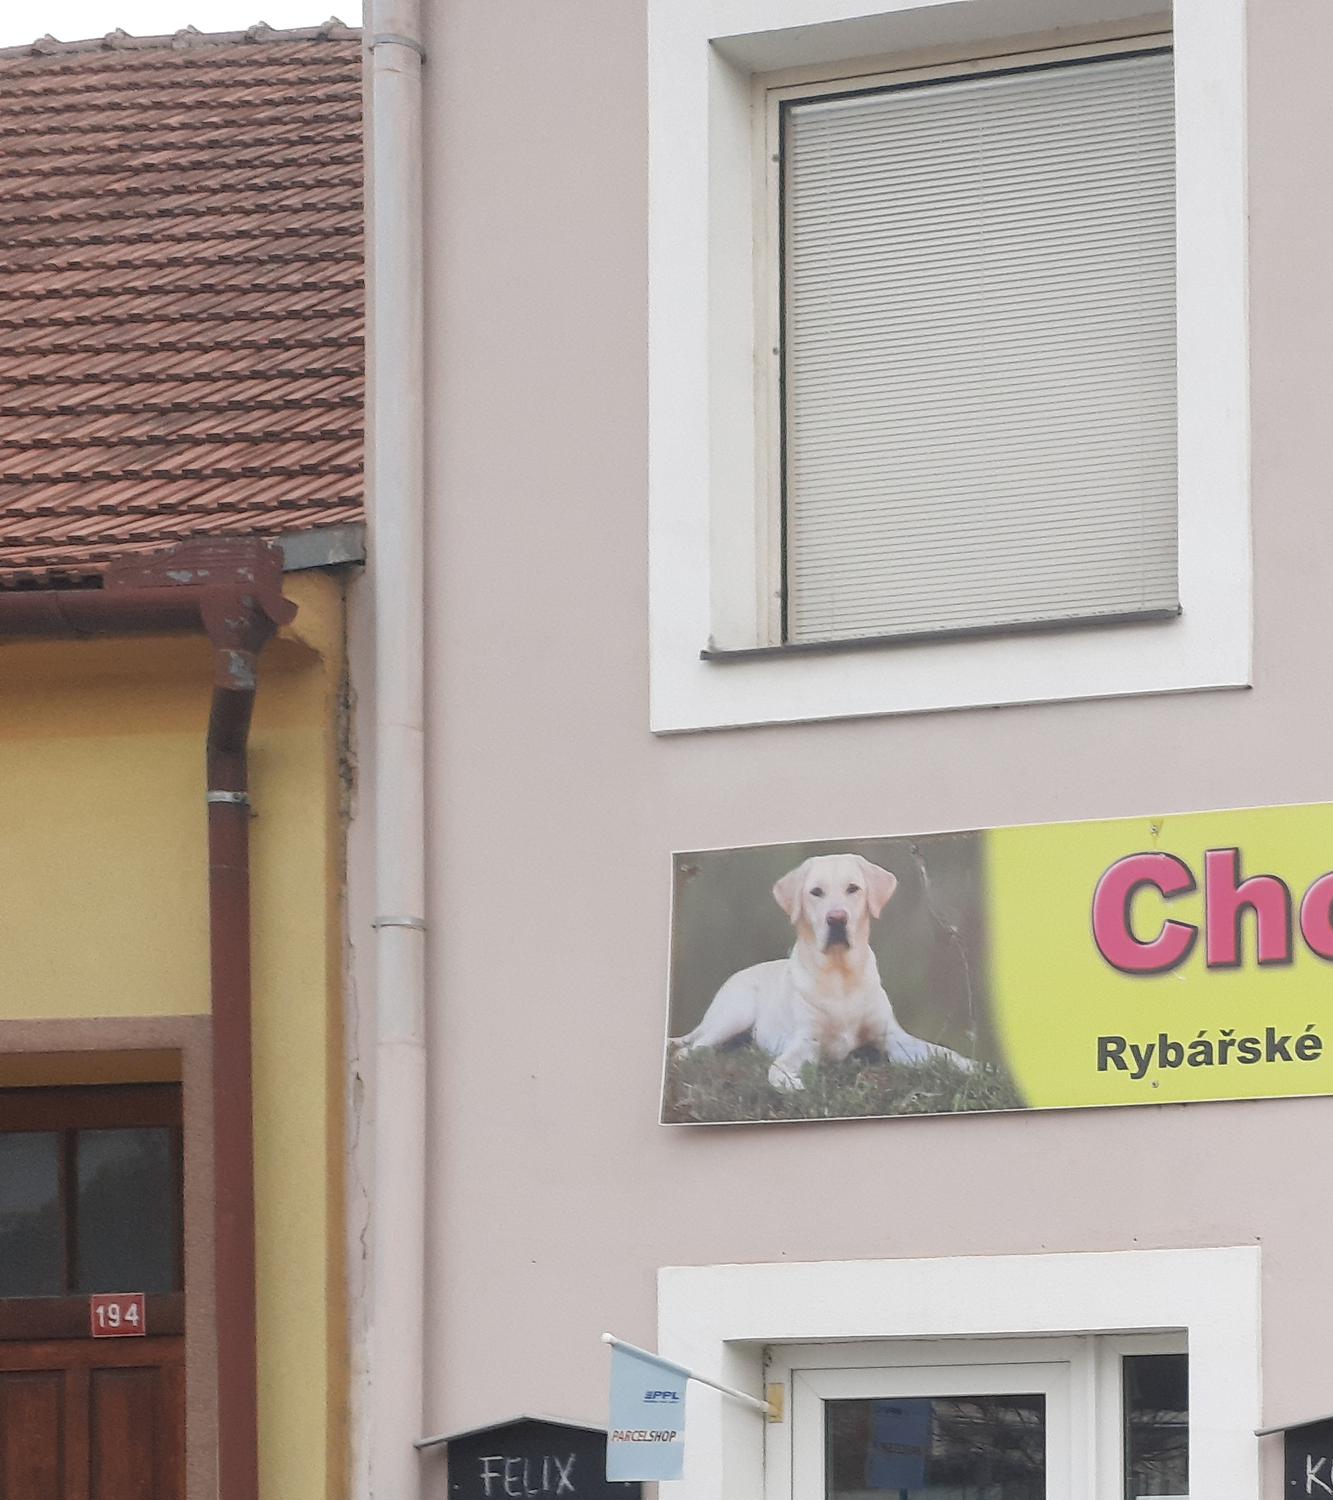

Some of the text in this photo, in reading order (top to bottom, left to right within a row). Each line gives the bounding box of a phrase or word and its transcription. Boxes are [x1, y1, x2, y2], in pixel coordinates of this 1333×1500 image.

[1097, 1024, 1323, 1079] Rybářské
[95, 1303, 139, 1328] 194
[650, 1390, 680, 1400] PPL
[612, 1430, 677, 1442] PARCELSHOP
[478, 1453, 577, 1497] FELIX
